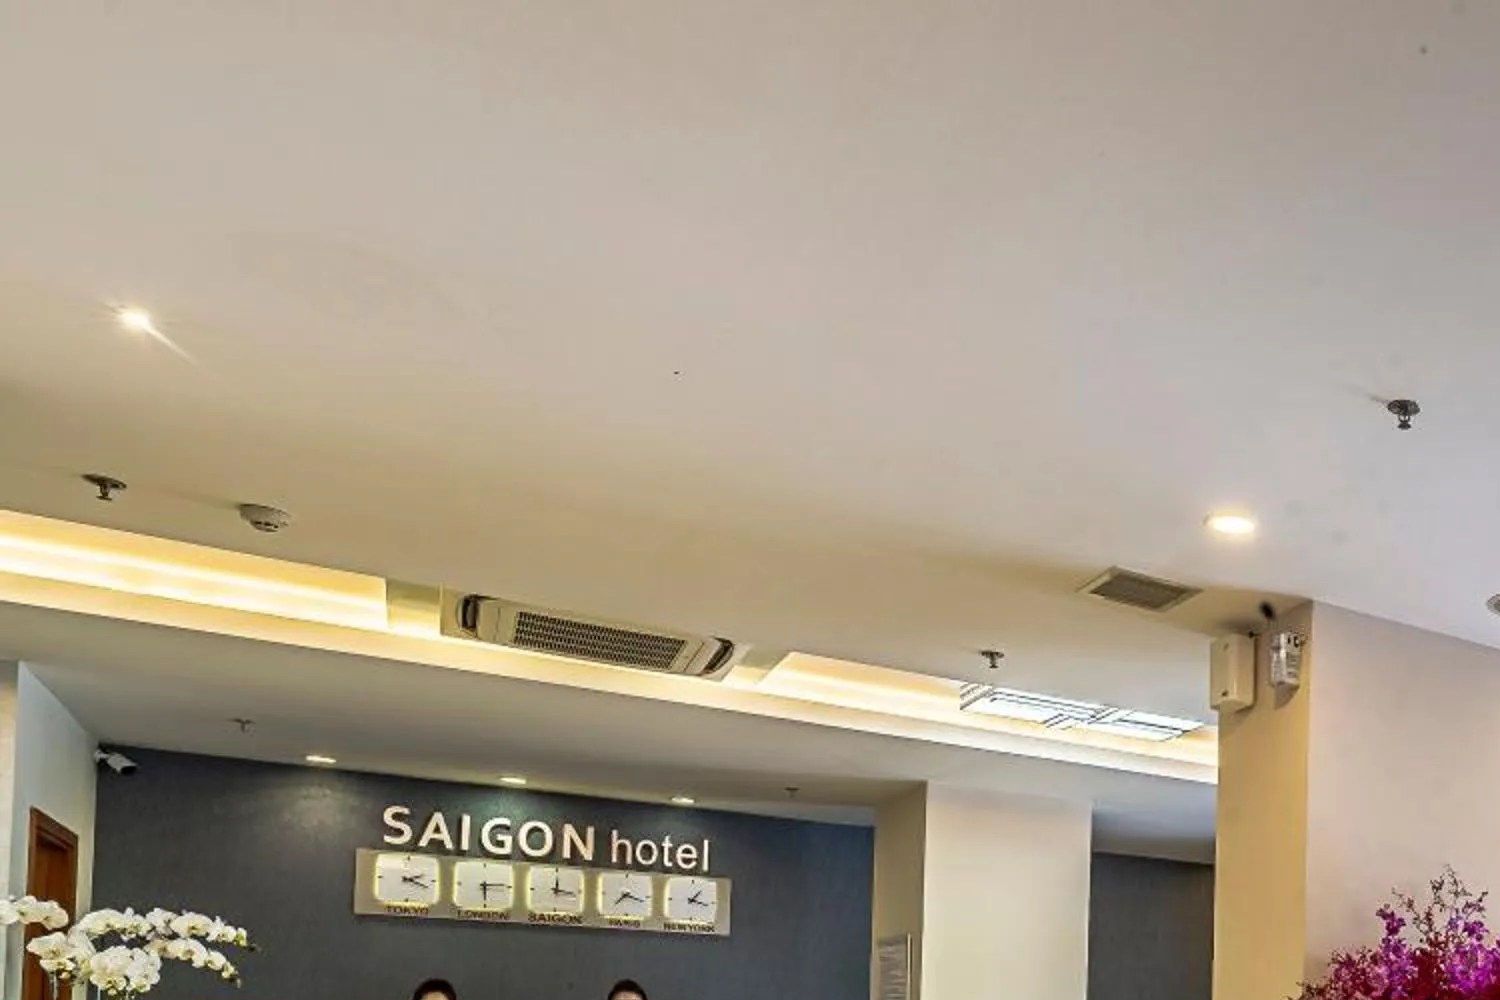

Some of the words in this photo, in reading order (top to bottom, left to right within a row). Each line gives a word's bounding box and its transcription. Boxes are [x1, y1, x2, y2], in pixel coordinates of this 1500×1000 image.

[383, 806, 595, 861] SAIGON
[611, 830, 710, 871] hotel
[527, 912, 583, 925] SAIGON
